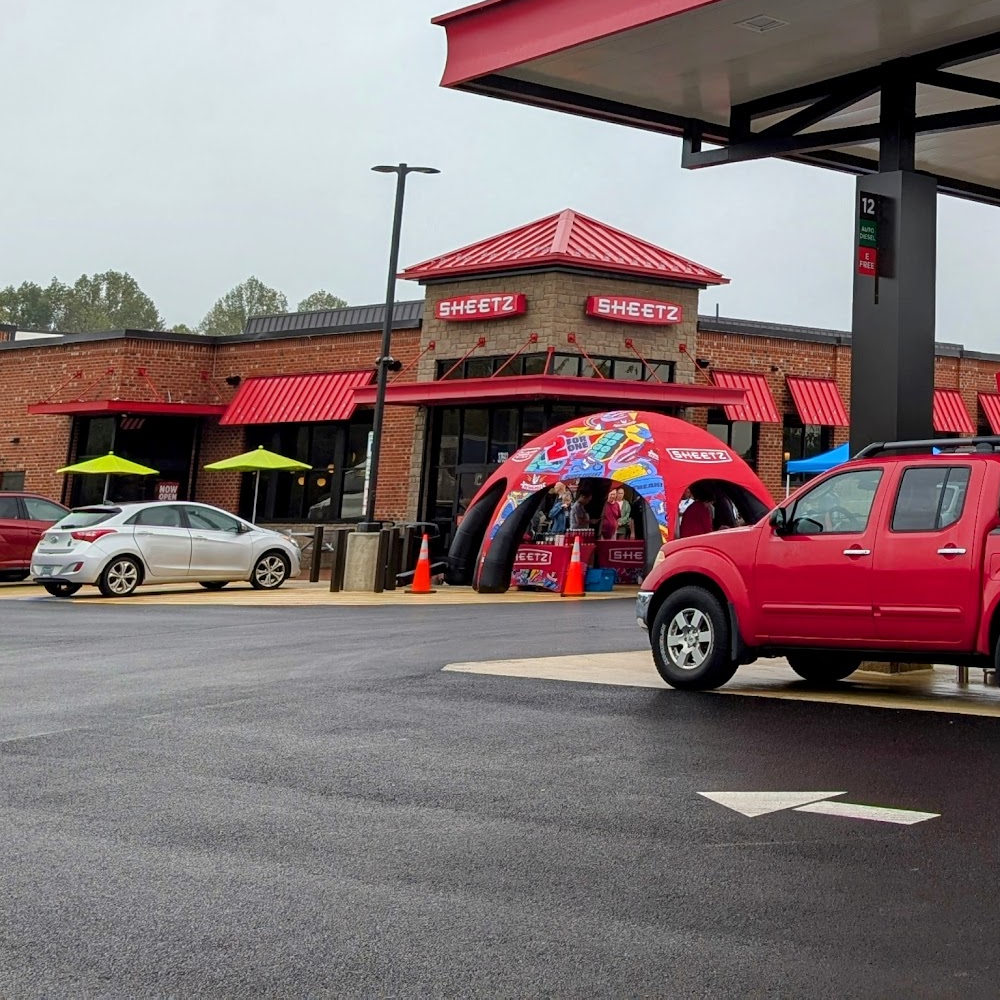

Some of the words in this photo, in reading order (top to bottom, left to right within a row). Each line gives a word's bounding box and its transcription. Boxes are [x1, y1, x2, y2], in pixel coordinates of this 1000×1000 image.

[861, 197, 875, 215] 12
[861, 226, 875, 234] AUTO
[860, 232, 876, 241] DIESEL
[865, 252, 869, 260] E
[859, 260, 875, 270] FREE
[439, 295, 514, 317] SHEETZ
[598, 299, 678, 321] SHEETZ
[566, 436, 587, 445] FOR
[567, 442, 589, 452] ONE
[671, 450, 727, 460] SHEETZ
[159, 485, 178, 493] NOW
[158, 493, 178, 501] OPEN
[613, 550, 643, 560] SHE
